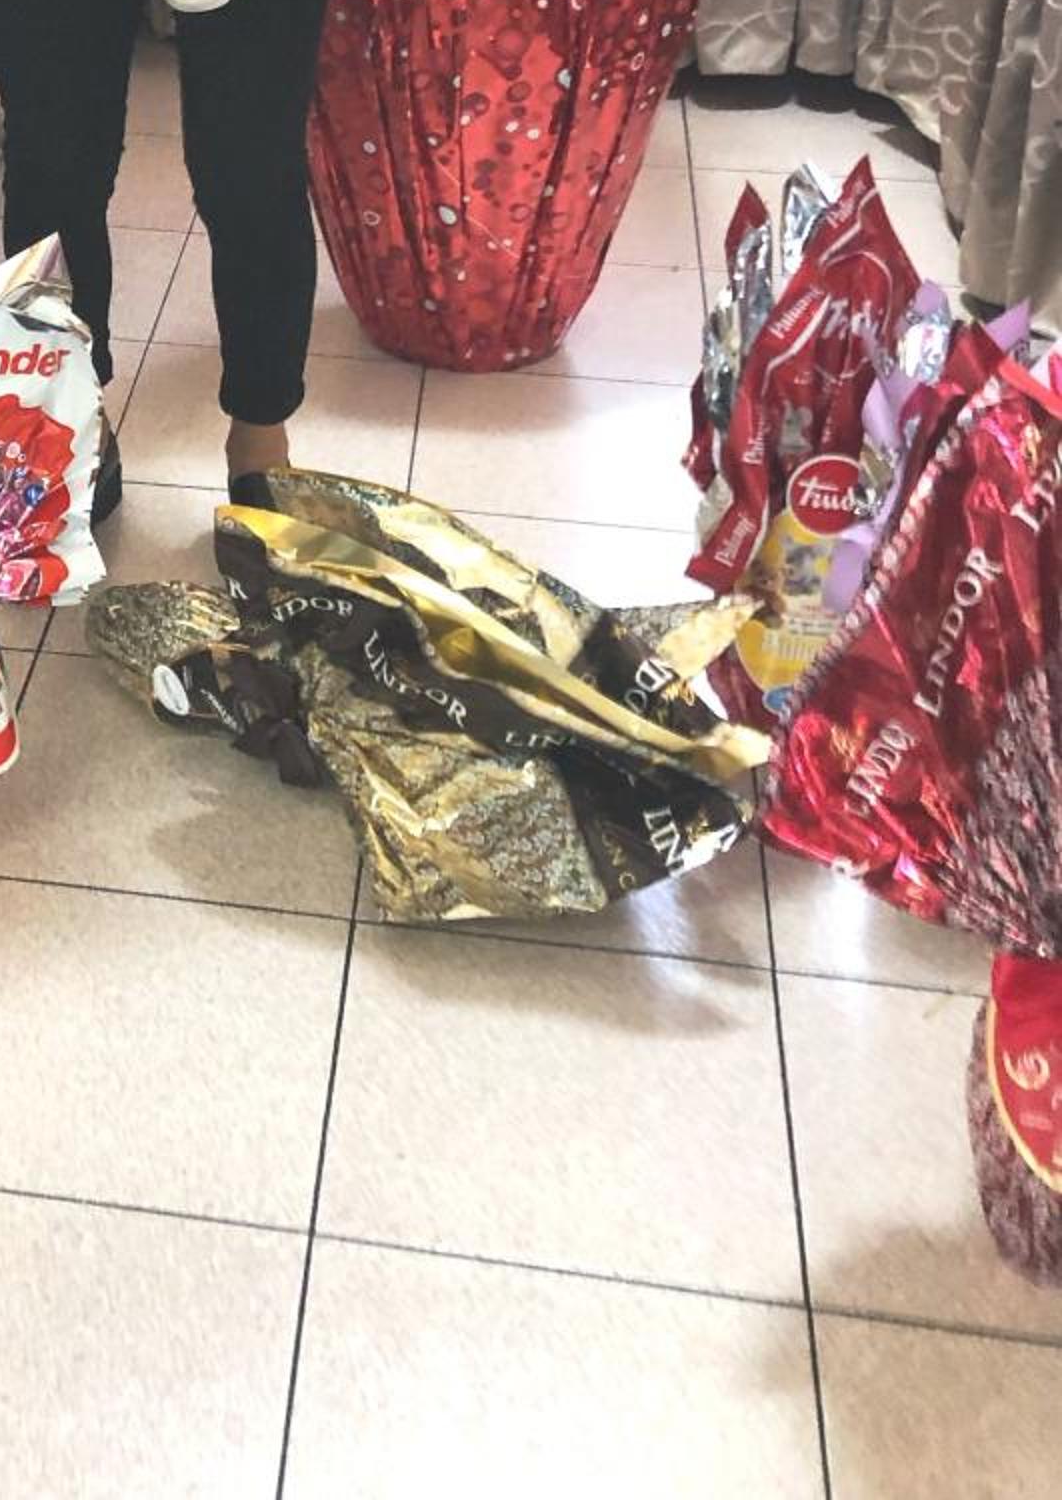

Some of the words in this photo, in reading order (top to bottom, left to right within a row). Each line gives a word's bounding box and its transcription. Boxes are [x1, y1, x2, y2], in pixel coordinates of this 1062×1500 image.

[797, 476, 862, 515] Trud
[269, 595, 355, 626] NDOR
[913, 546, 1004, 719] LINDOR
[845, 718, 918, 819] LINDO
